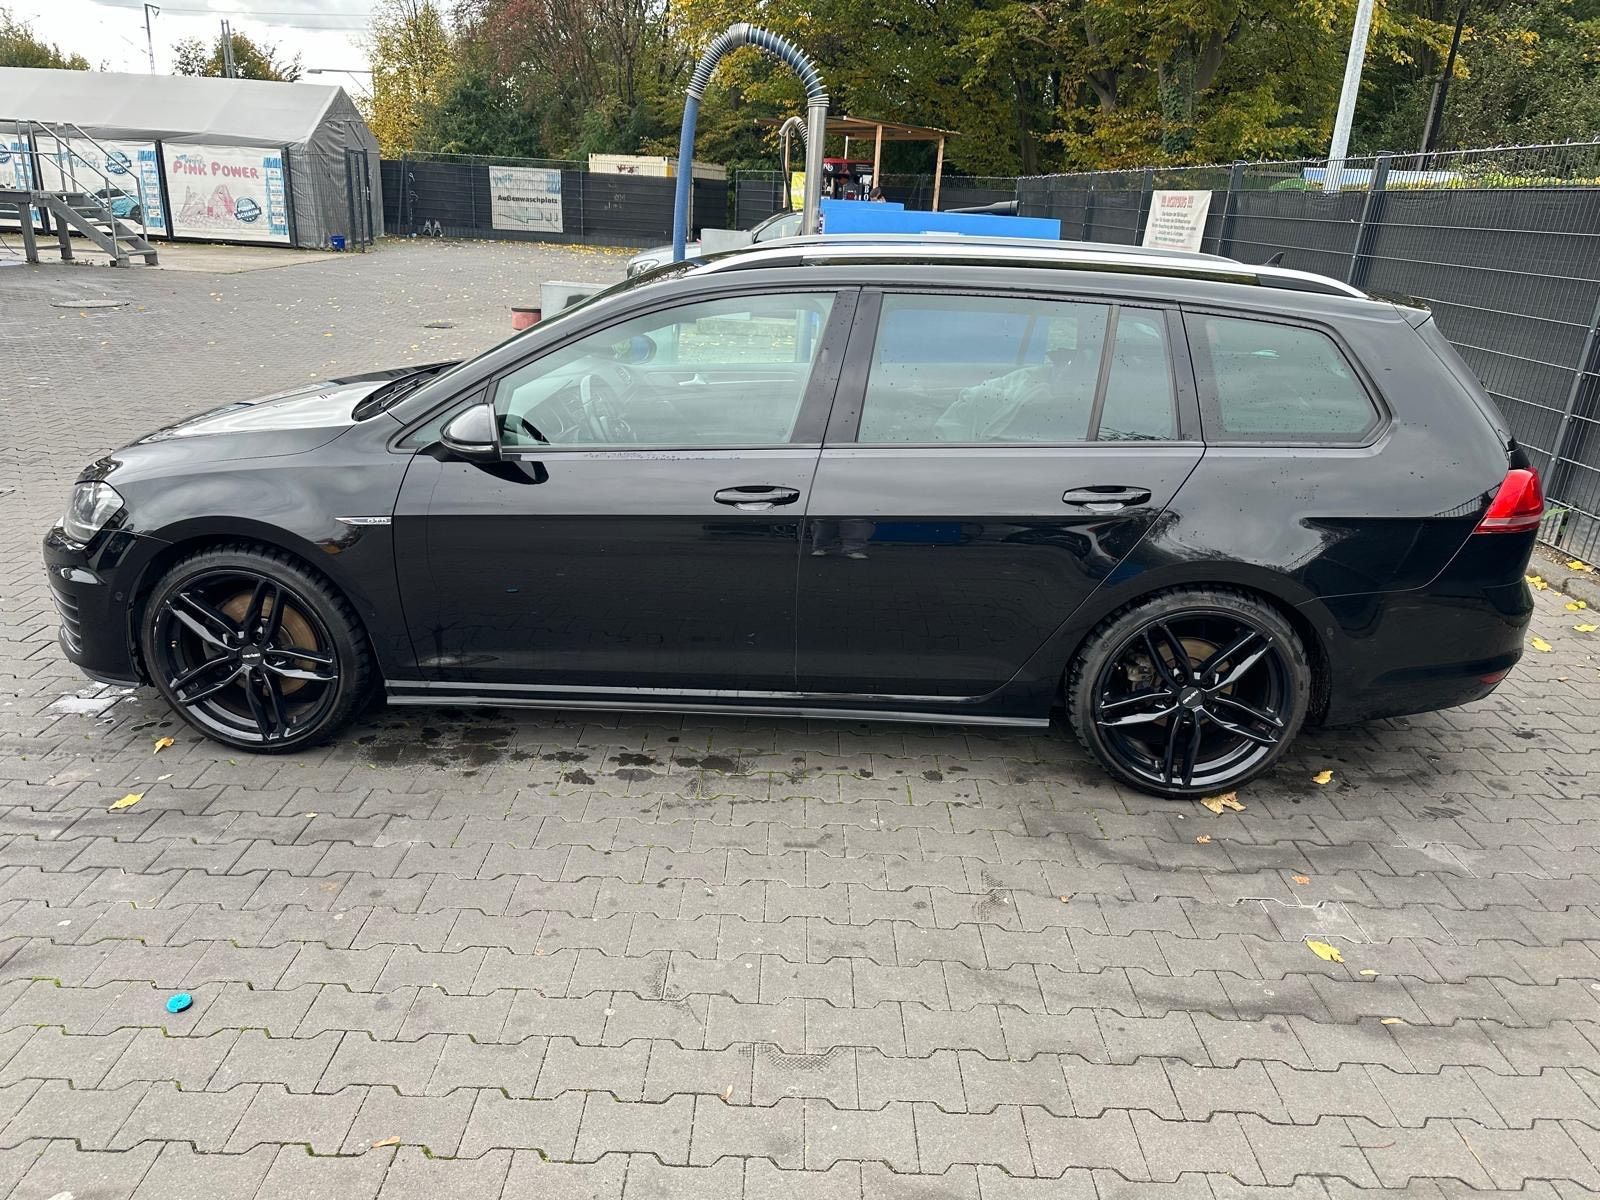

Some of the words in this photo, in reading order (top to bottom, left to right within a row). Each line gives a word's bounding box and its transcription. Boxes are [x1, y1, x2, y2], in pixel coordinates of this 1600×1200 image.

[173, 160, 207, 176] PINK
[211, 161, 259, 179] POWER
[497, 194, 558, 204] Außenwaschplatz
